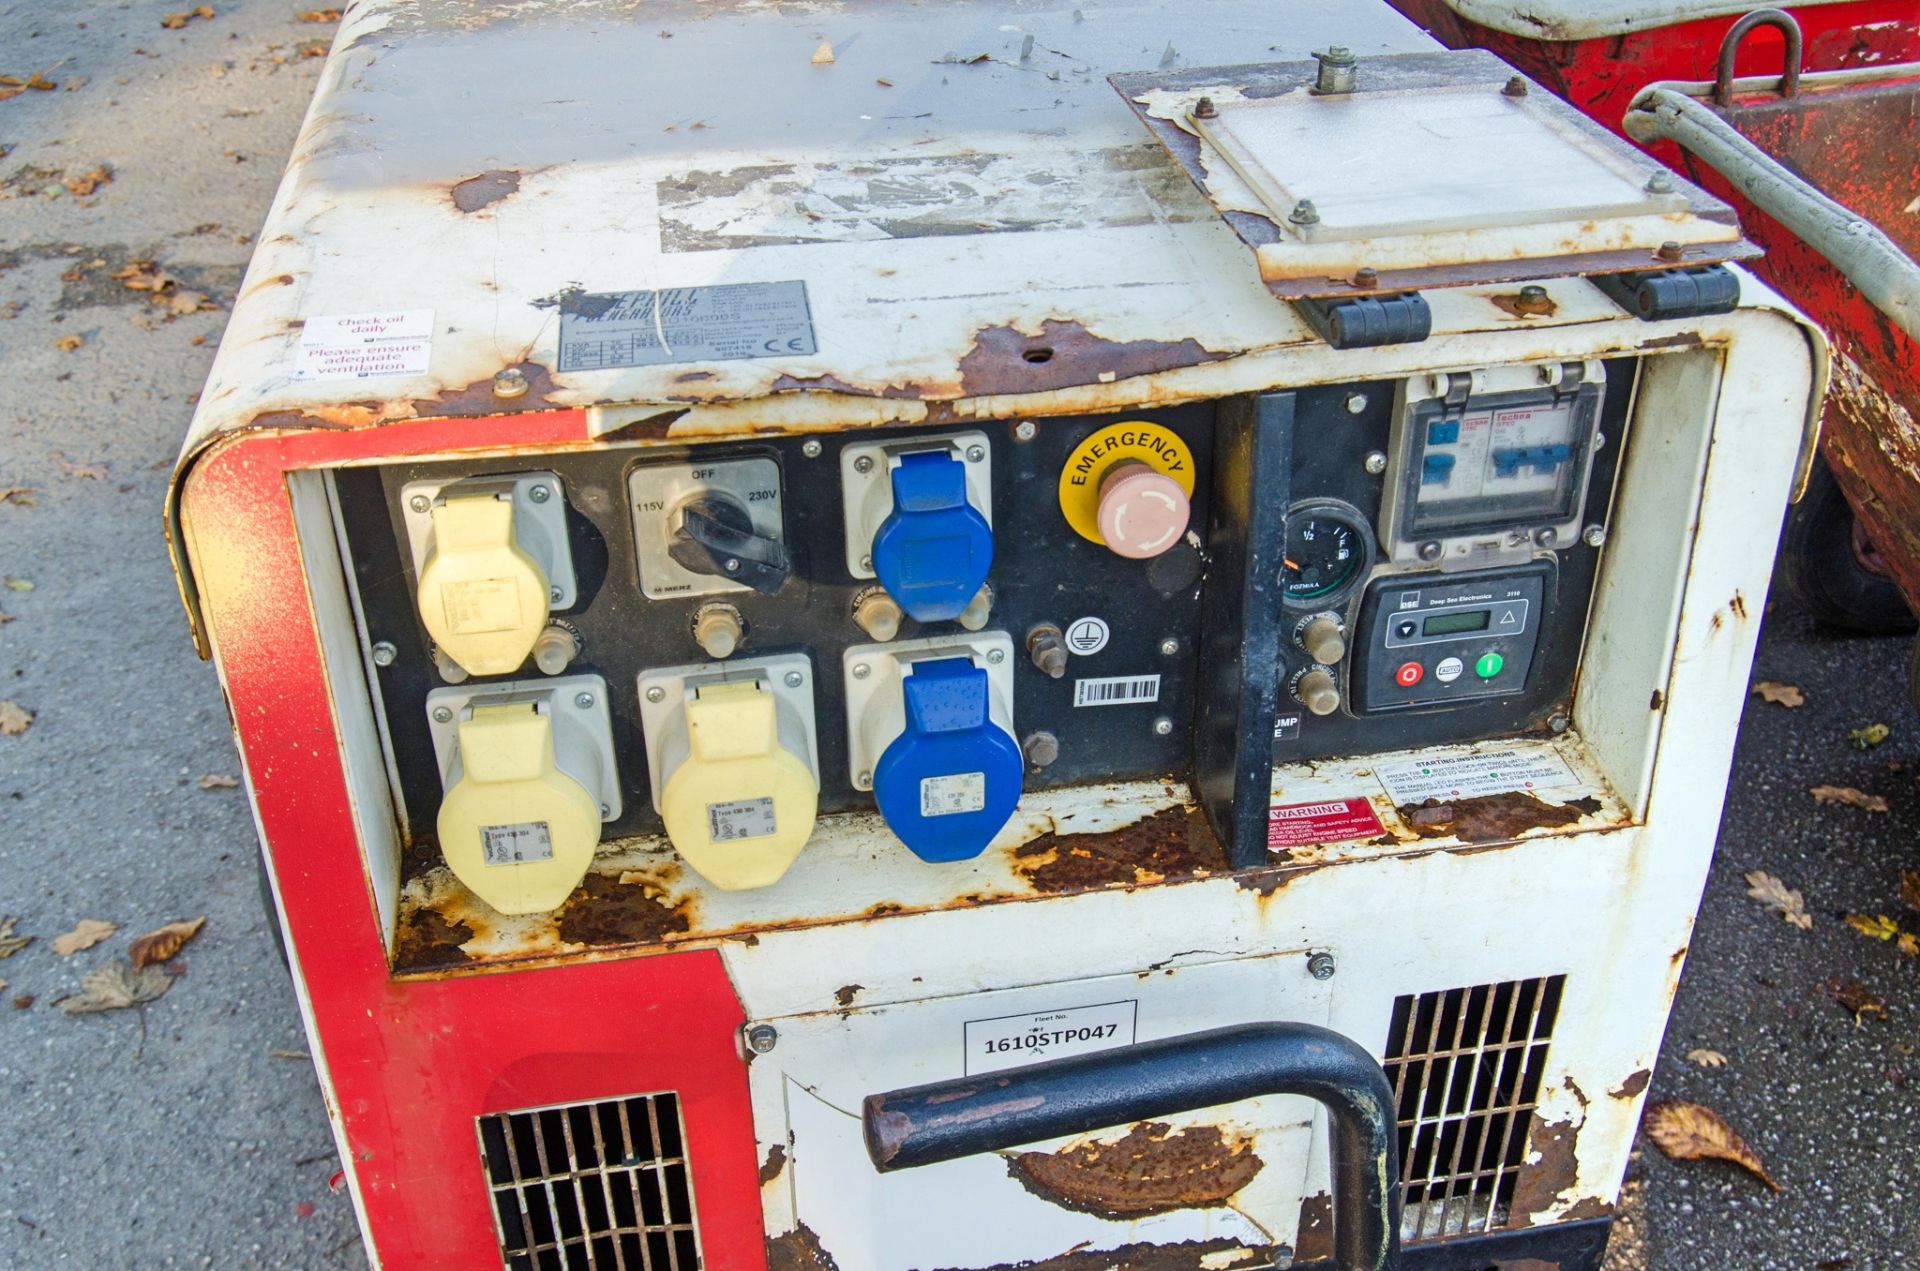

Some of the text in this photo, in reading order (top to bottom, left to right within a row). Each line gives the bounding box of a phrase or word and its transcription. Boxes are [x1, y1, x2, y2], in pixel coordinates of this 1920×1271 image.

[338, 315, 404, 326] Check oil
[351, 325, 387, 334] daily
[309, 344, 421, 357] Please ensure
[324, 353, 402, 364] adequate
[317, 363, 406, 375] ventilation
[1071, 431, 1184, 487] EMERGENCY
[691, 468, 716, 480] OFF
[749, 489, 777, 502] 230V
[636, 501, 665, 513] 115V
[1339, 539, 1346, 548] F
[664, 584, 692, 592] MERZ
[1401, 600, 1419, 609] DSE
[1429, 598, 1445, 606] Deep
[1459, 593, 1493, 602] Electronics
[1440, 665, 1460, 674] AUTO
[1415, 751, 1516, 768] STARTING INSTRUCTIONS
[1272, 804, 1344, 818] WARNING
[1350, 816, 1373, 824] ADVICE
[1336, 827, 1358, 835] SPEED
[1342, 829, 1378, 839] EQUIPMENT
[1034, 1013, 1069, 1023] Fleet No.
[985, 1023, 1118, 1054] 1610STP047
